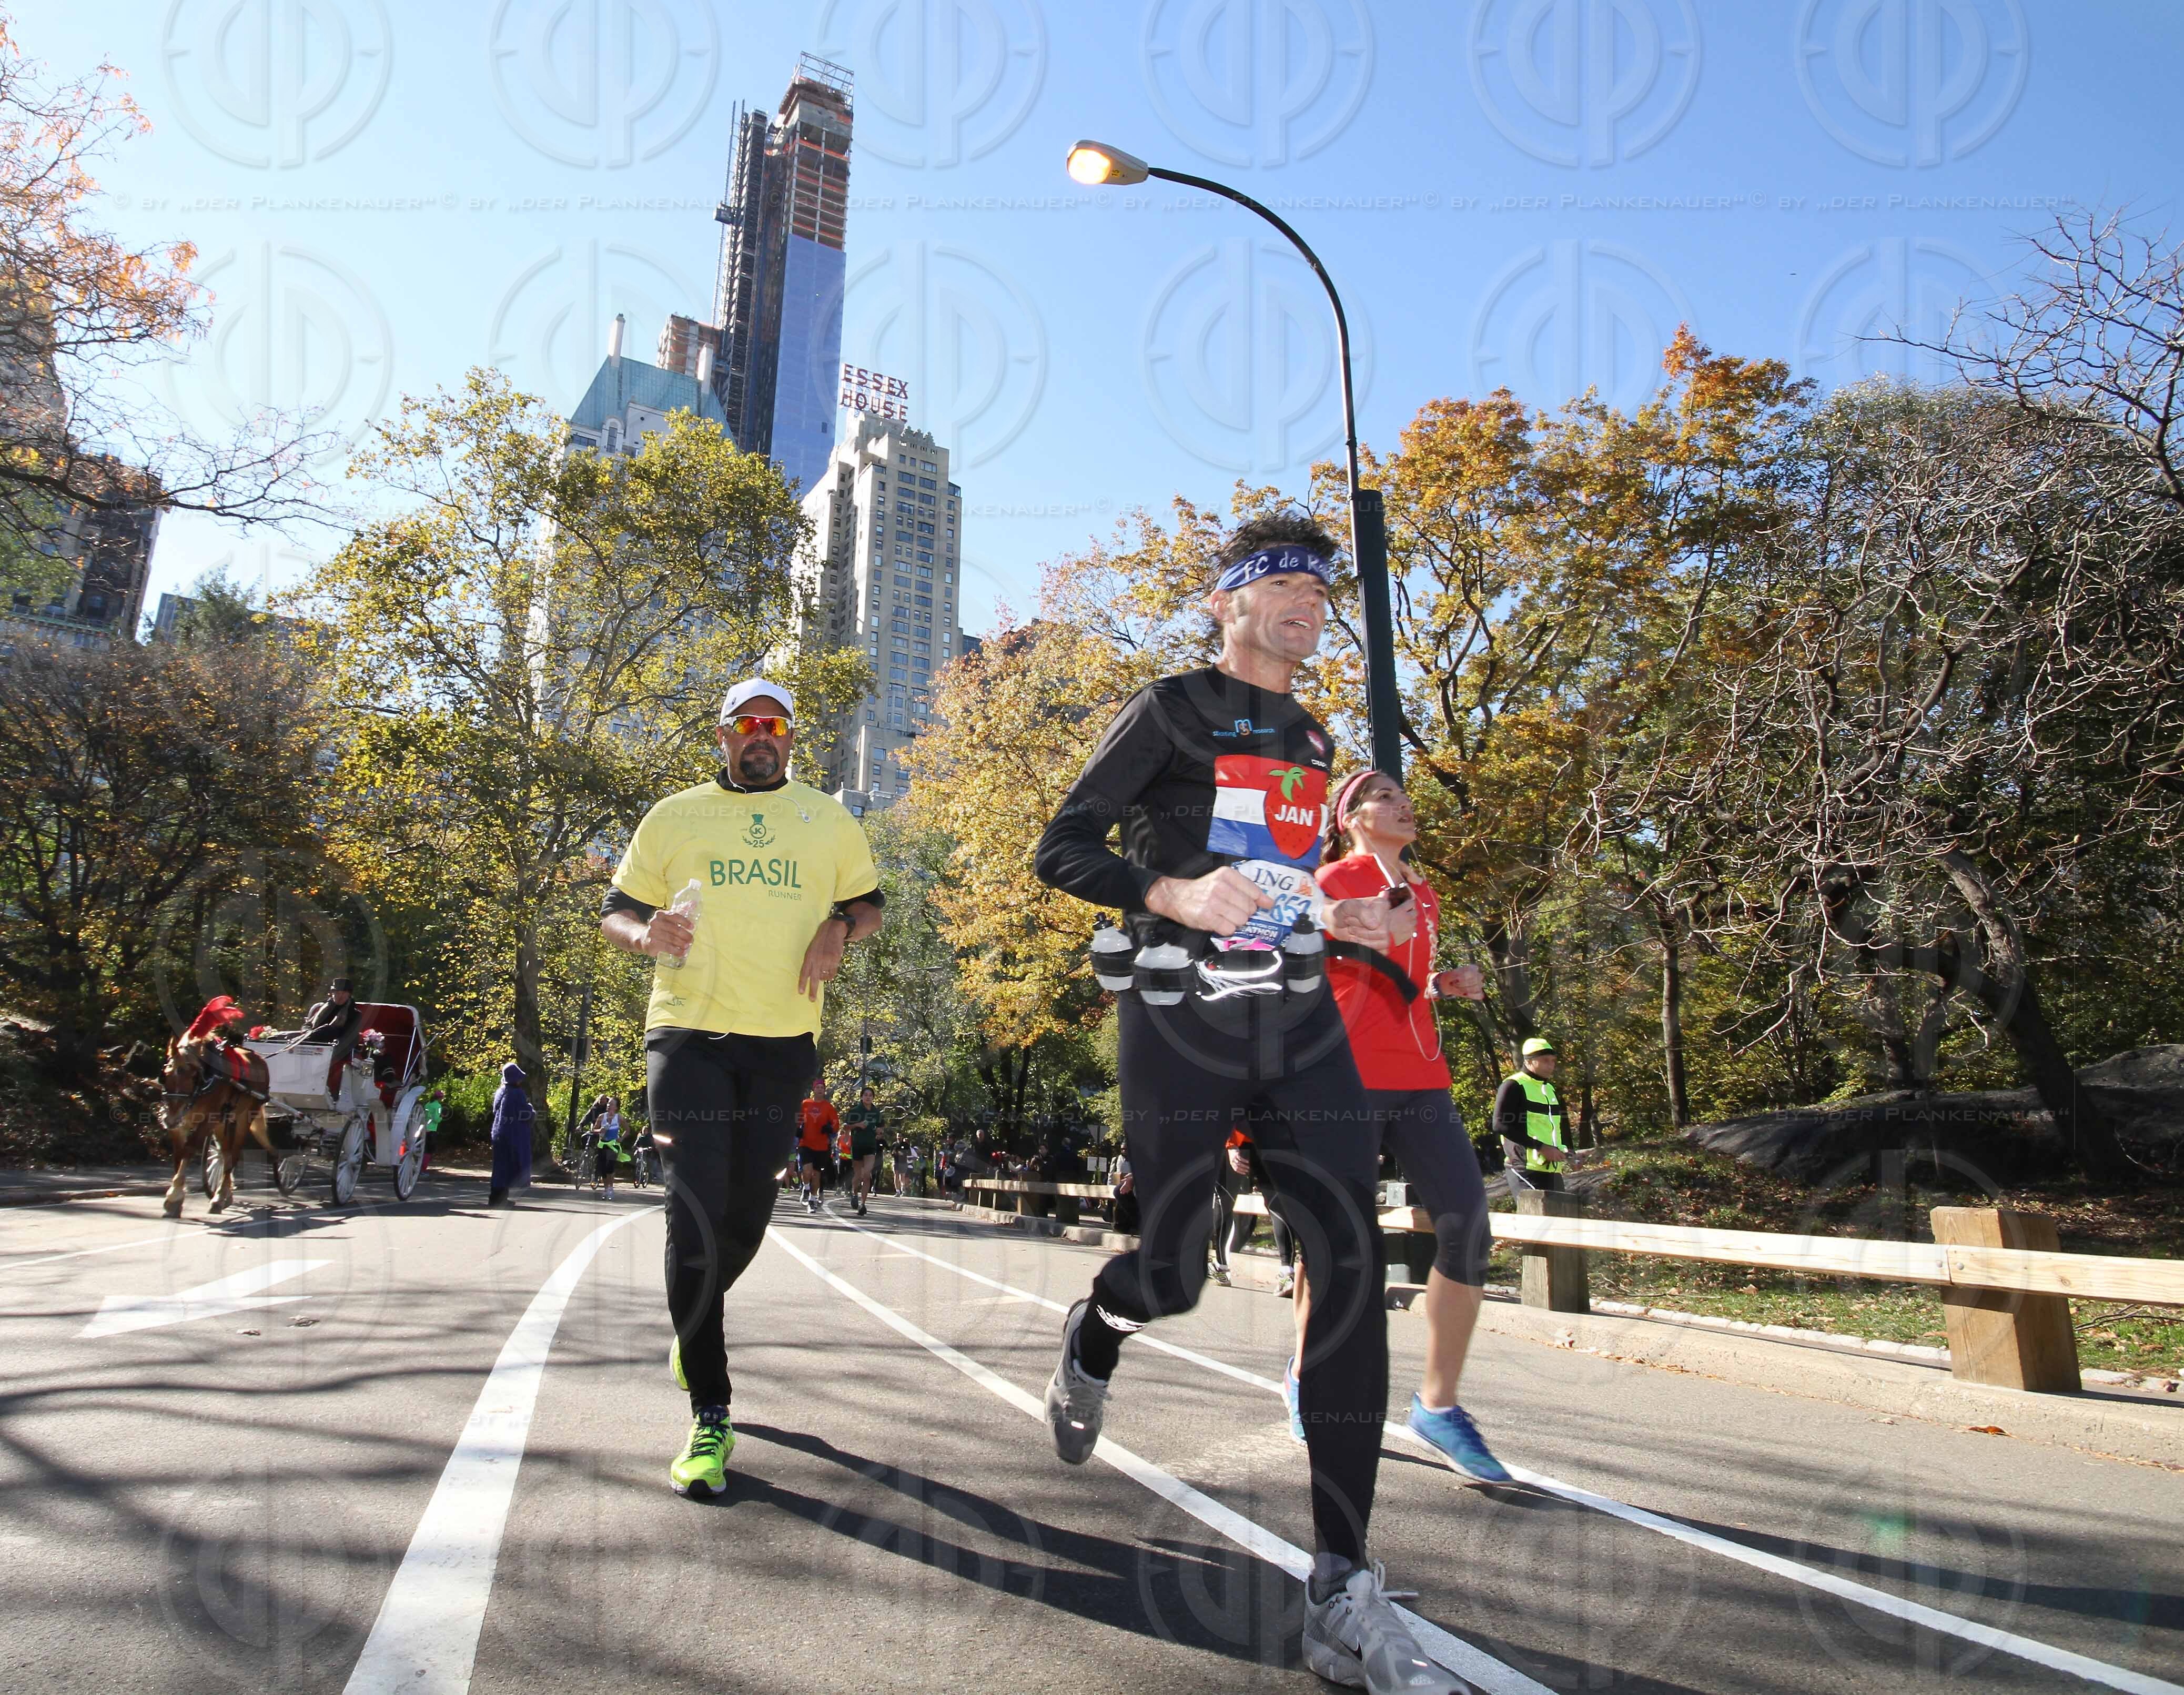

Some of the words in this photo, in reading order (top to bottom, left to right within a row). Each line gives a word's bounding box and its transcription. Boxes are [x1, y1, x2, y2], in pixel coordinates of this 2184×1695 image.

[843, 363, 908, 400] ESSEX
[841, 388, 908, 422] HOUSE
[1279, 551, 1299, 568] de
[1274, 804, 1313, 827] JAN
[753, 839, 764, 848] 25
[710, 858, 802, 889] BRASIL
[1253, 867, 1294, 890] ING
[768, 890, 802, 901] RUNNER
